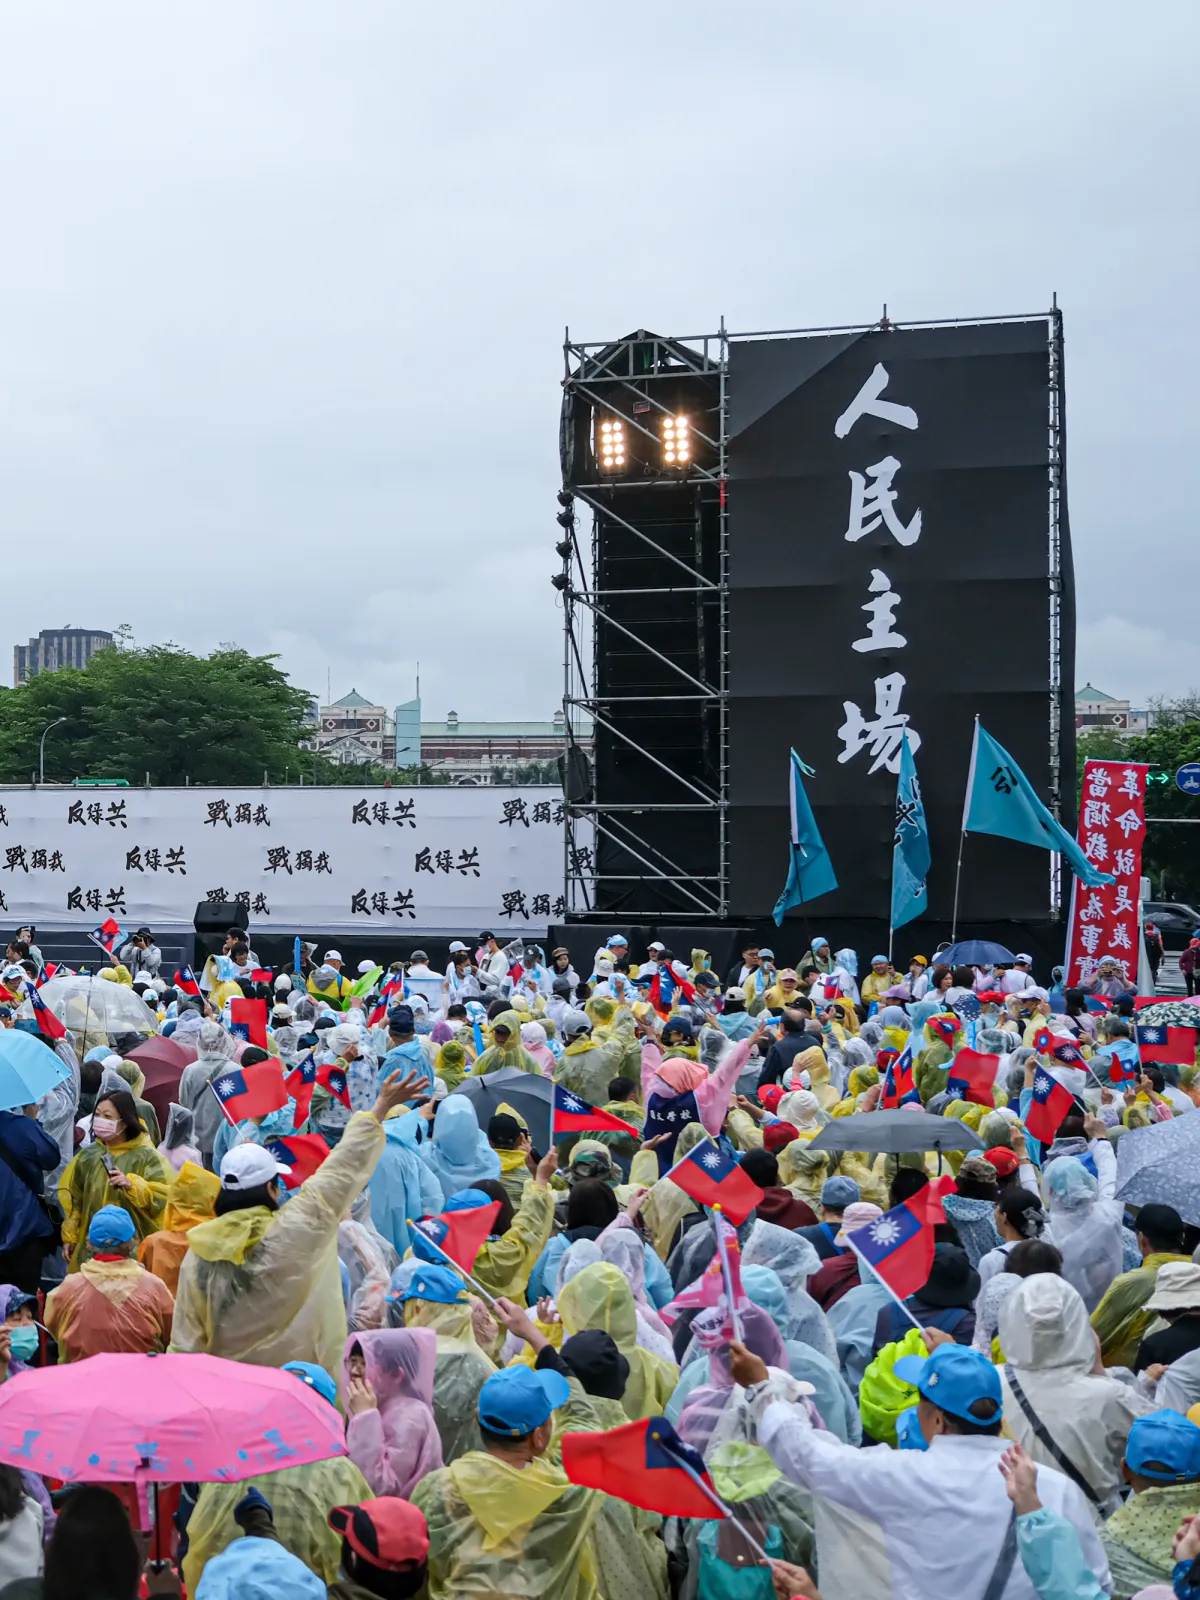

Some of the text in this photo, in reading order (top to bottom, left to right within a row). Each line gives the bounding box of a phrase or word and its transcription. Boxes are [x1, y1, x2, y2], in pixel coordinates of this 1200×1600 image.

[834, 361, 923, 776] 人民主場
[68, 800, 128, 829] 反綠共
[204, 799, 271, 828] 戰獨裁
[352, 798, 417, 829] 反綠共
[2, 845, 66, 873] 戰獨裁
[126, 846, 188, 876] 反綠共
[263, 846, 333, 876] 戰獨裁
[415, 847, 481, 878] 反綠共
[67, 886, 128, 916] 反綠共
[351, 888, 417, 919] 反綠共
